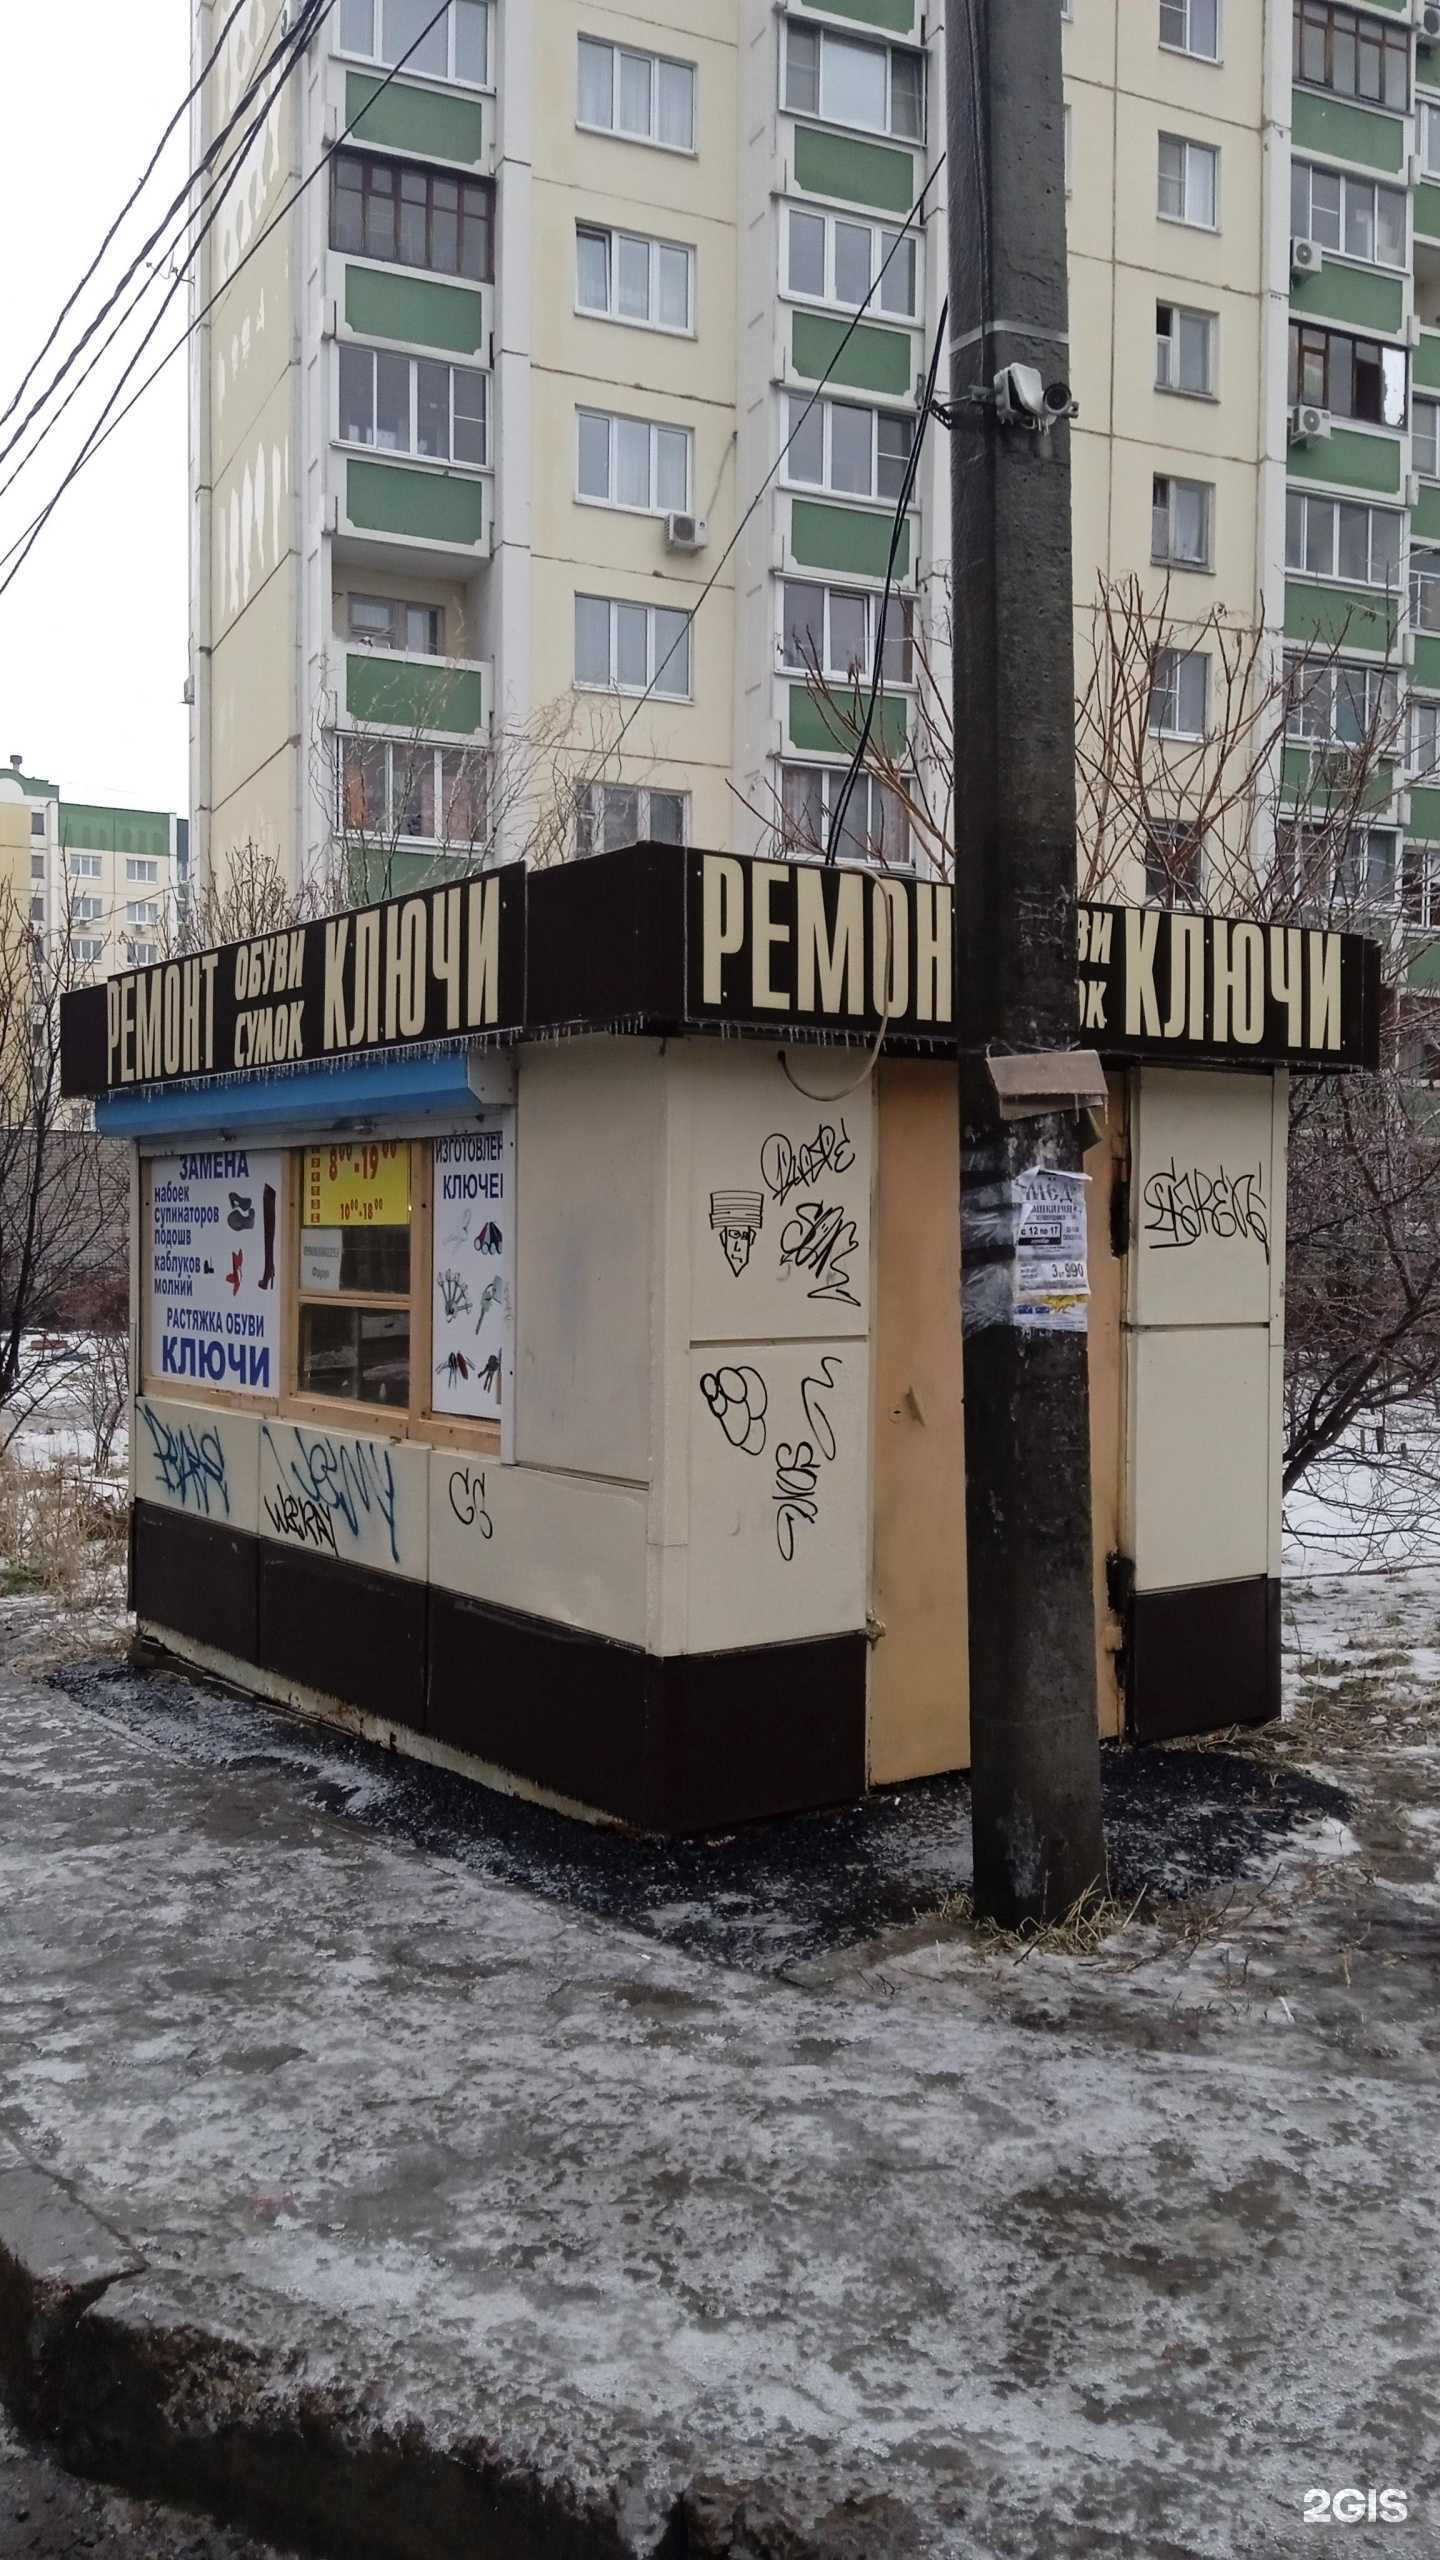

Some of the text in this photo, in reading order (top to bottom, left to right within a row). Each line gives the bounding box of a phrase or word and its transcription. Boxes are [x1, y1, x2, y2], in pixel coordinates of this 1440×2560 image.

[703, 854, 952, 1023] РЕМОН
[234, 929, 306, 1001] ОБУВИ
[324, 877, 499, 1051] КЛЮЧИ
[1124, 906, 1342, 1052] КЛЮЧИ
[107, 953, 219, 1085] РЕМОНТ
[234, 1000, 305, 1069] СУМОК
[179, 1152, 249, 1181] ЗАМЕНА
[154, 1180, 190, 1203] набоек
[154, 1205, 220, 1229] супинаторов
[154, 1229, 192, 1248] подошв
[154, 1250, 201, 1278] каблуков
[154, 1274, 193, 1297] молний
[167, 1306, 265, 1338] РАСТЯЖКА ОБУВИ
[162, 1335, 270, 1388] КЛЮЧИ
